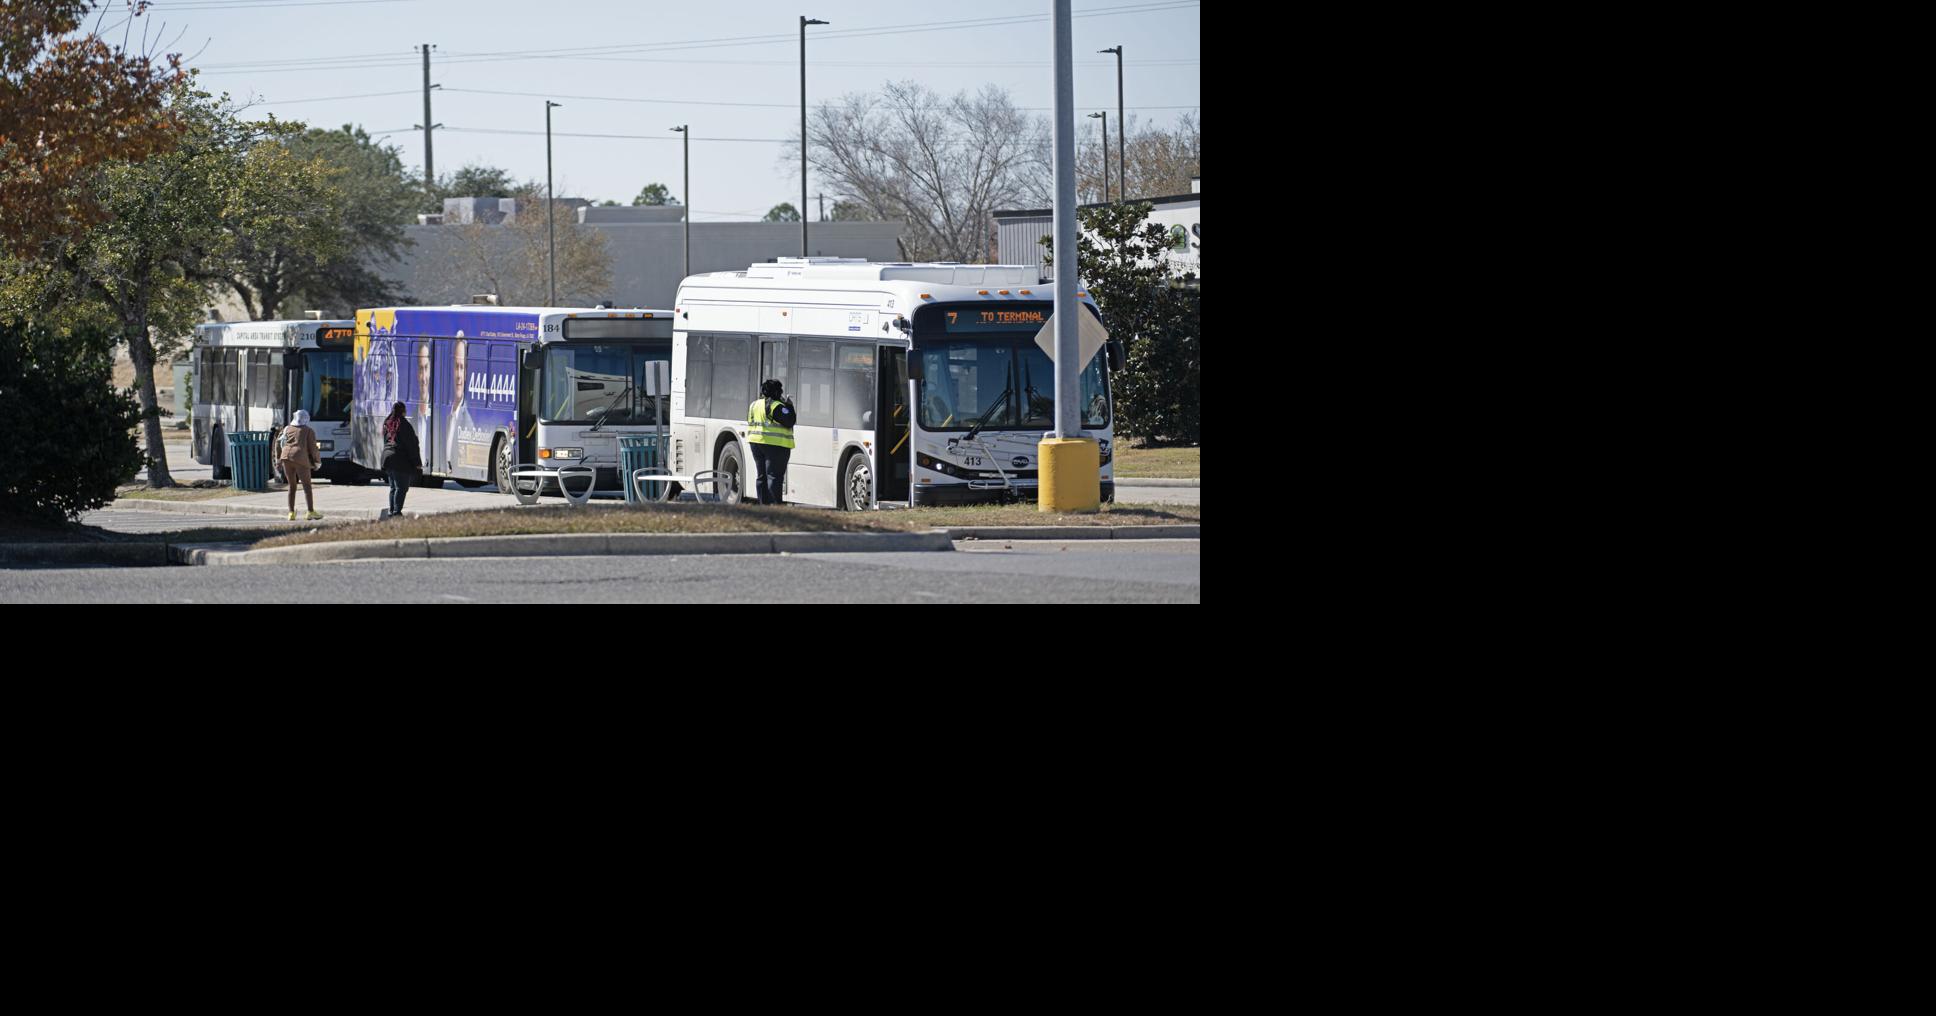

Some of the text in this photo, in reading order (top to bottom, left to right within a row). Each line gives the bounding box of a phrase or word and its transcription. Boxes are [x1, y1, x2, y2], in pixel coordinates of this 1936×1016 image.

[948, 312, 957, 324] 7
[981, 312, 1044, 321] TO TERMINAL
[544, 324, 560, 332] 184
[236, 332, 250, 340] CAPITAL
[250, 332, 259, 340] AREA
[260, 332, 273, 340] TRANSIT
[324, 329, 341, 339] 47
[964, 456, 981, 466] 413
